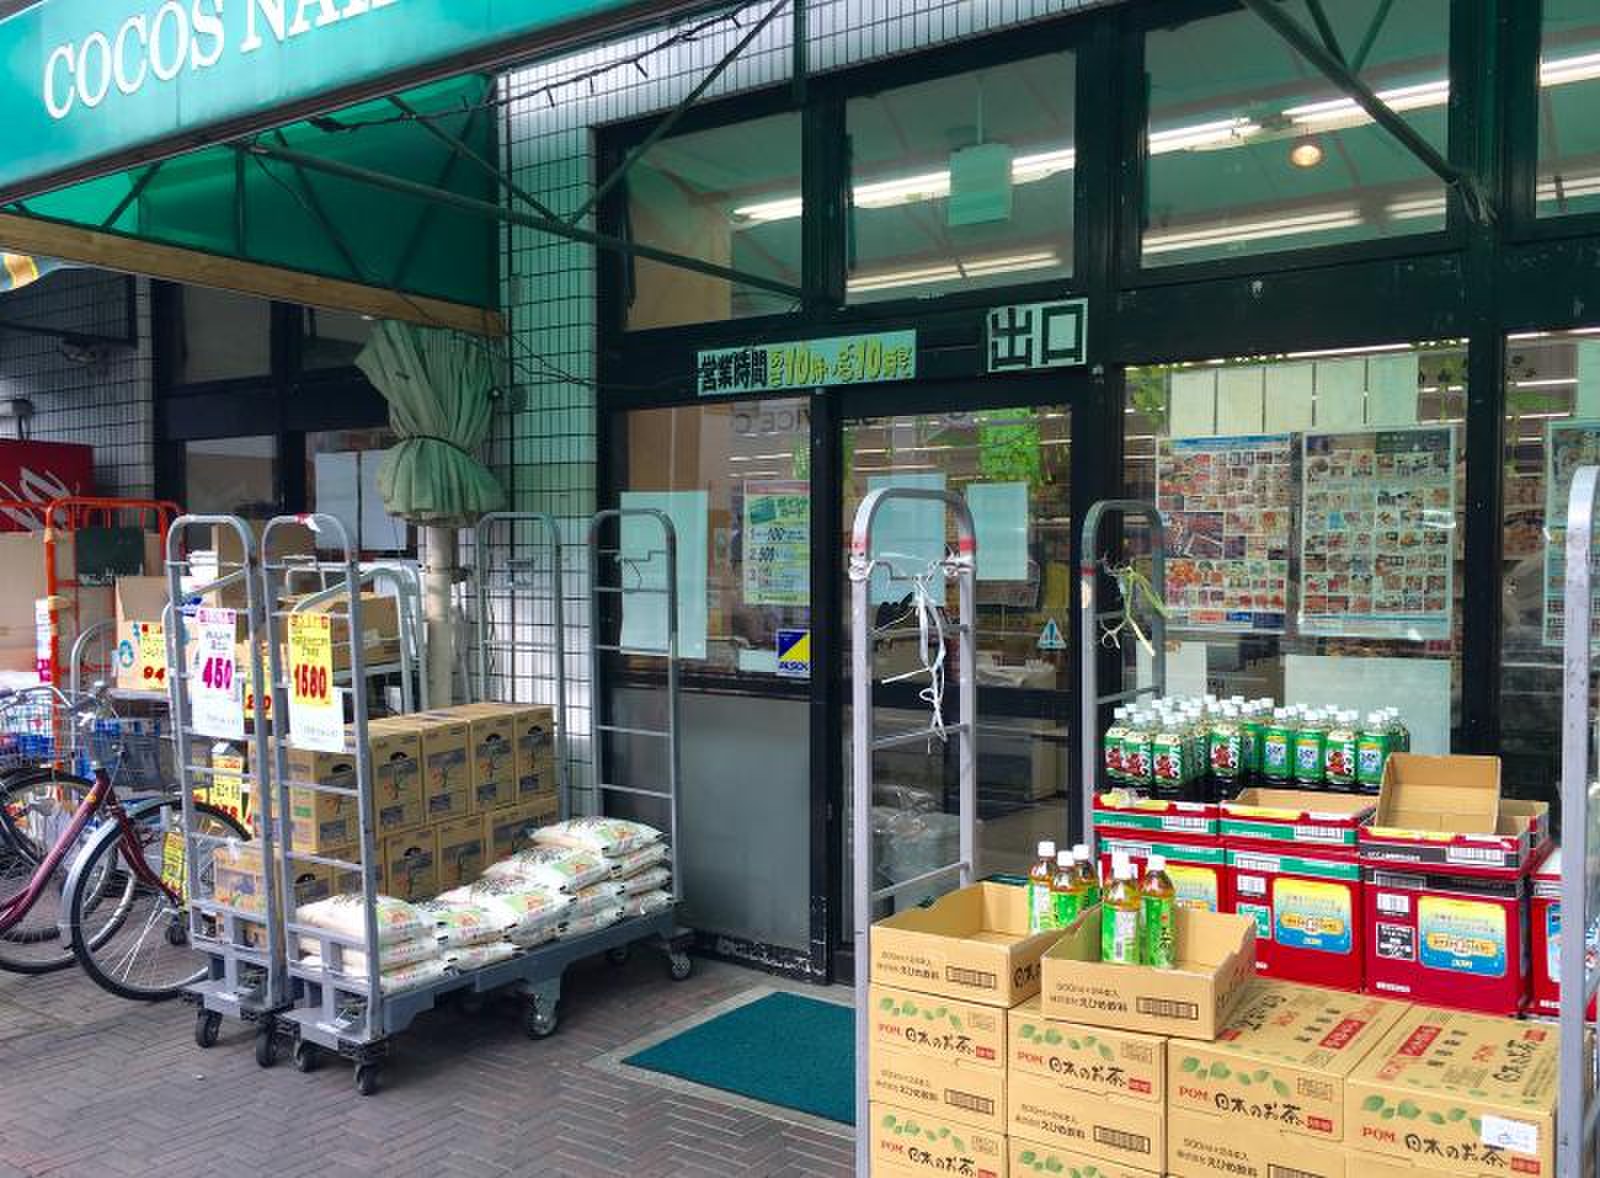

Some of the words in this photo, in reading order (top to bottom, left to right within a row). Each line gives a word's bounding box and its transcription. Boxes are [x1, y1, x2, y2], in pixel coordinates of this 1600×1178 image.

[43, 0, 225, 119] COCOS
[991, 303, 1084, 369] 出口
[202, 657, 232, 689] 450
[294, 664, 327, 699] 1580
[1178, 1085, 1209, 1101] POM
[1215, 1092, 1306, 1127] 日本のお茶
[1362, 1126, 1397, 1144] POM
